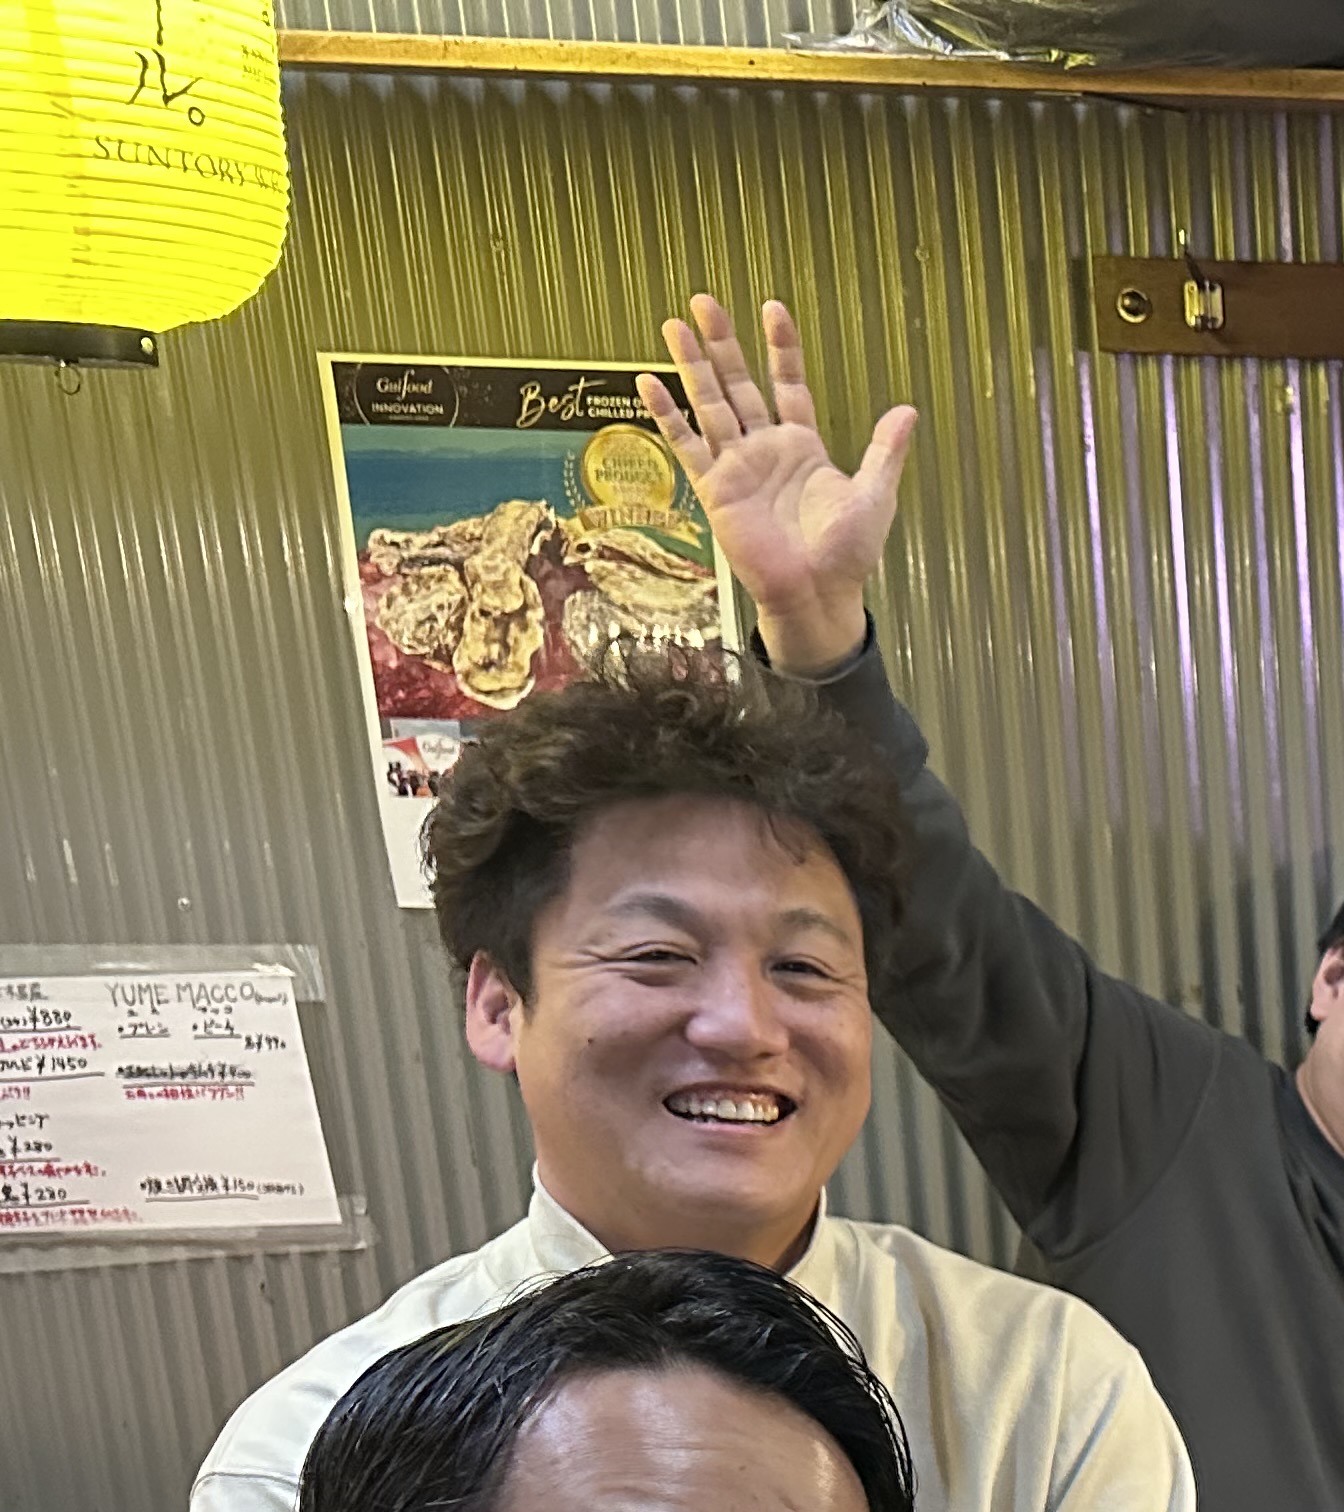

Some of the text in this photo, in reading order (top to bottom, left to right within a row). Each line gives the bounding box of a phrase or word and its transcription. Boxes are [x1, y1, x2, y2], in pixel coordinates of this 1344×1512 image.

[94, 135, 247, 186] SUNTORY
[371, 401, 444, 415] INNOVATION
[516, 376, 607, 428] Best
[104, 982, 170, 1008] YUME
[175, 981, 255, 1007] MACCO
